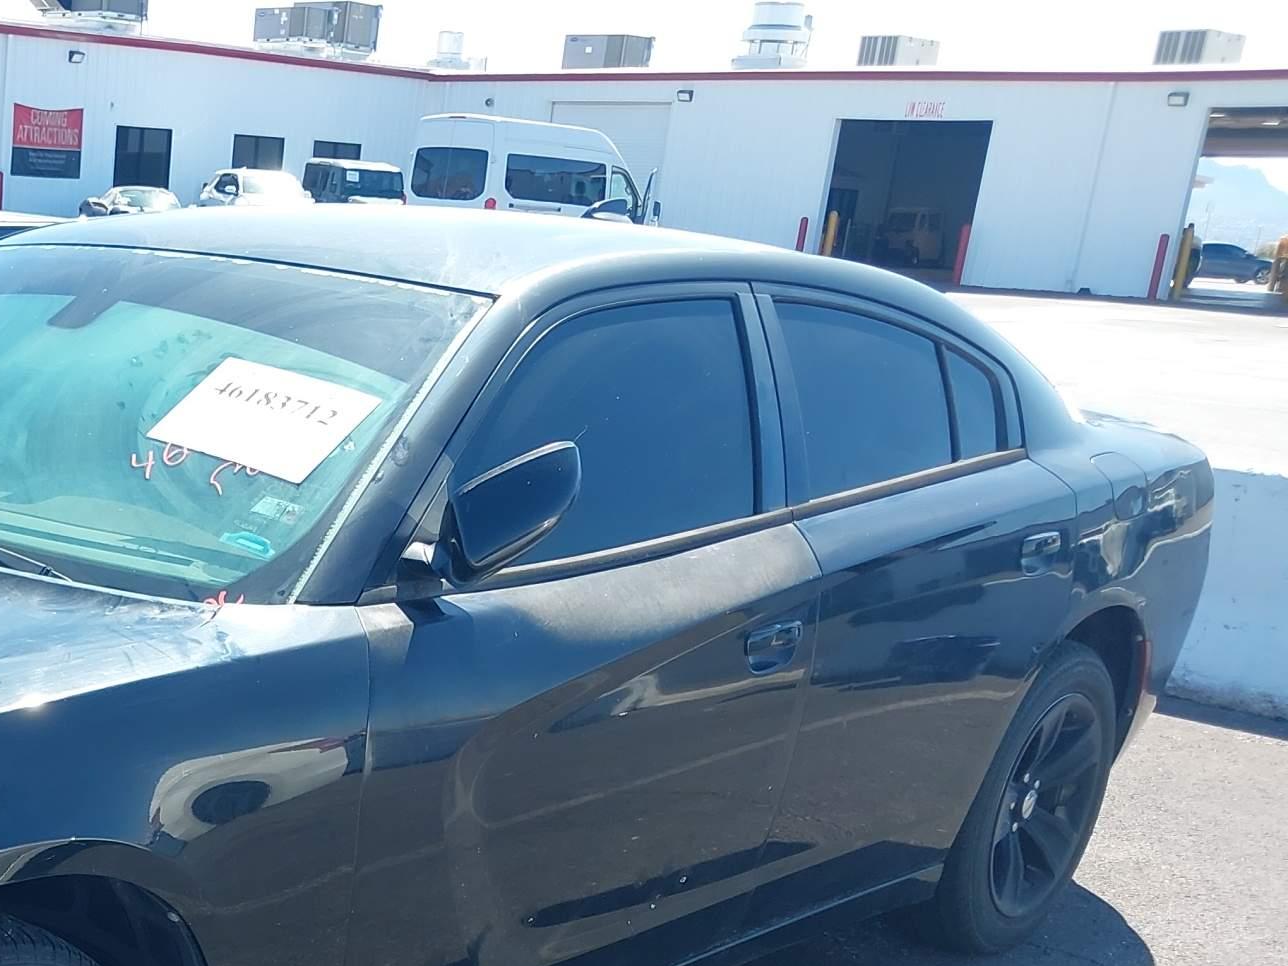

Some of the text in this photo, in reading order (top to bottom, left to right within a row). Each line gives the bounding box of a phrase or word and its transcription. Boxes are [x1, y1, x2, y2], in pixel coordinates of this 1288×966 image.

[30, 109, 68, 126] COMING
[16, 124, 79, 145] ATTRACTIONS
[215, 381, 338, 426] 46183712
